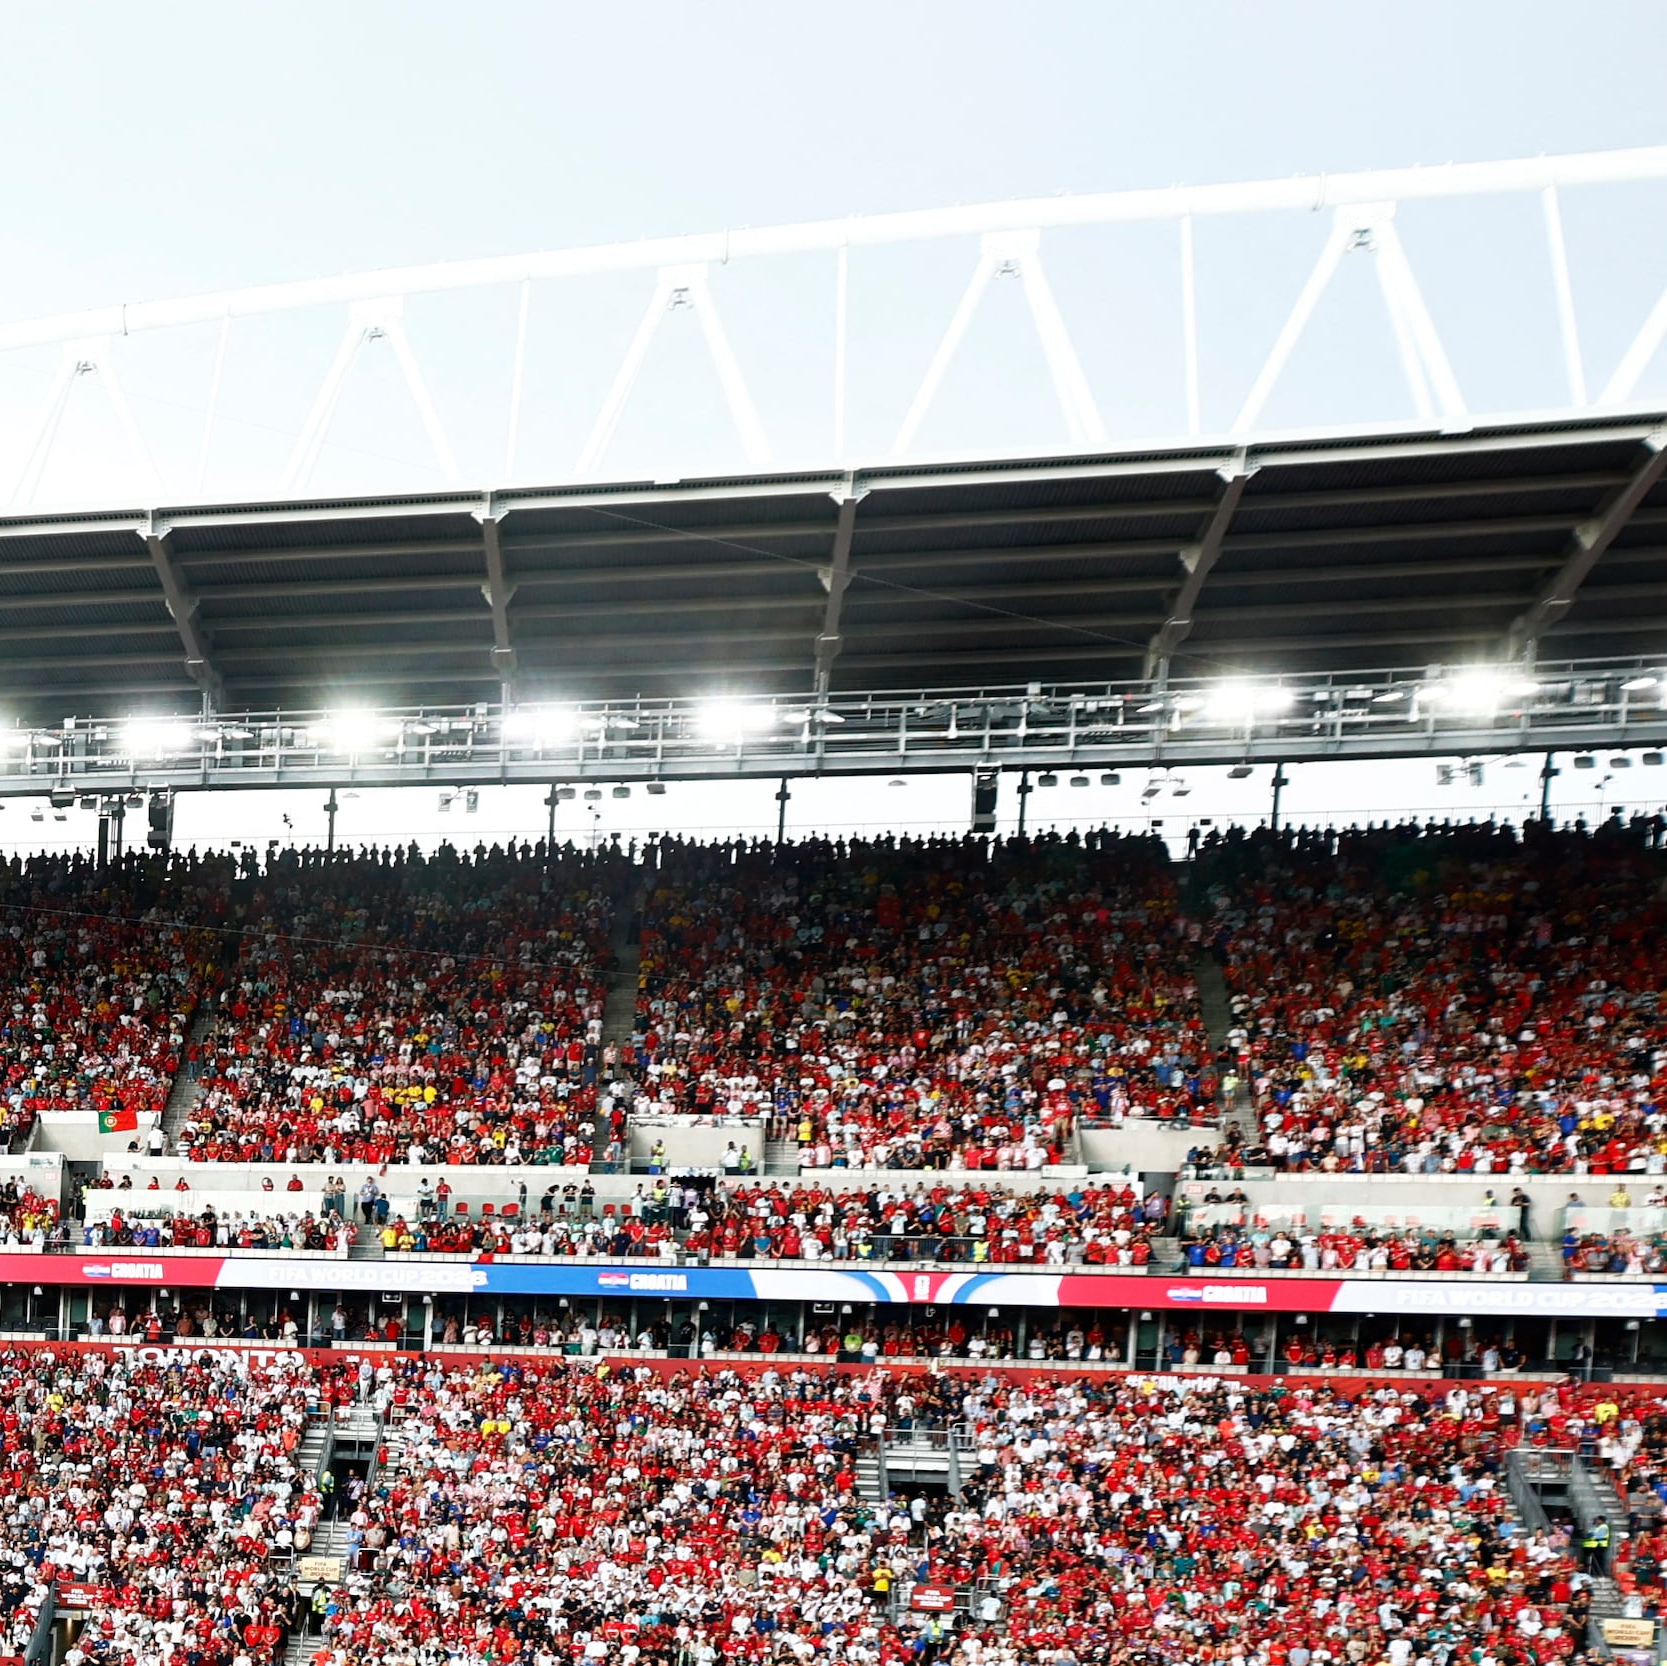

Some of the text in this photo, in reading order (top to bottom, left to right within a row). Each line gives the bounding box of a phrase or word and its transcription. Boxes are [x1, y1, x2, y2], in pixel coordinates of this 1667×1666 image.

[111, 1263, 164, 1281] CROATIA
[421, 1269, 487, 1287] 2026
[629, 1272, 688, 1291] CROATIA
[1202, 1285, 1268, 1304] CROATIA
